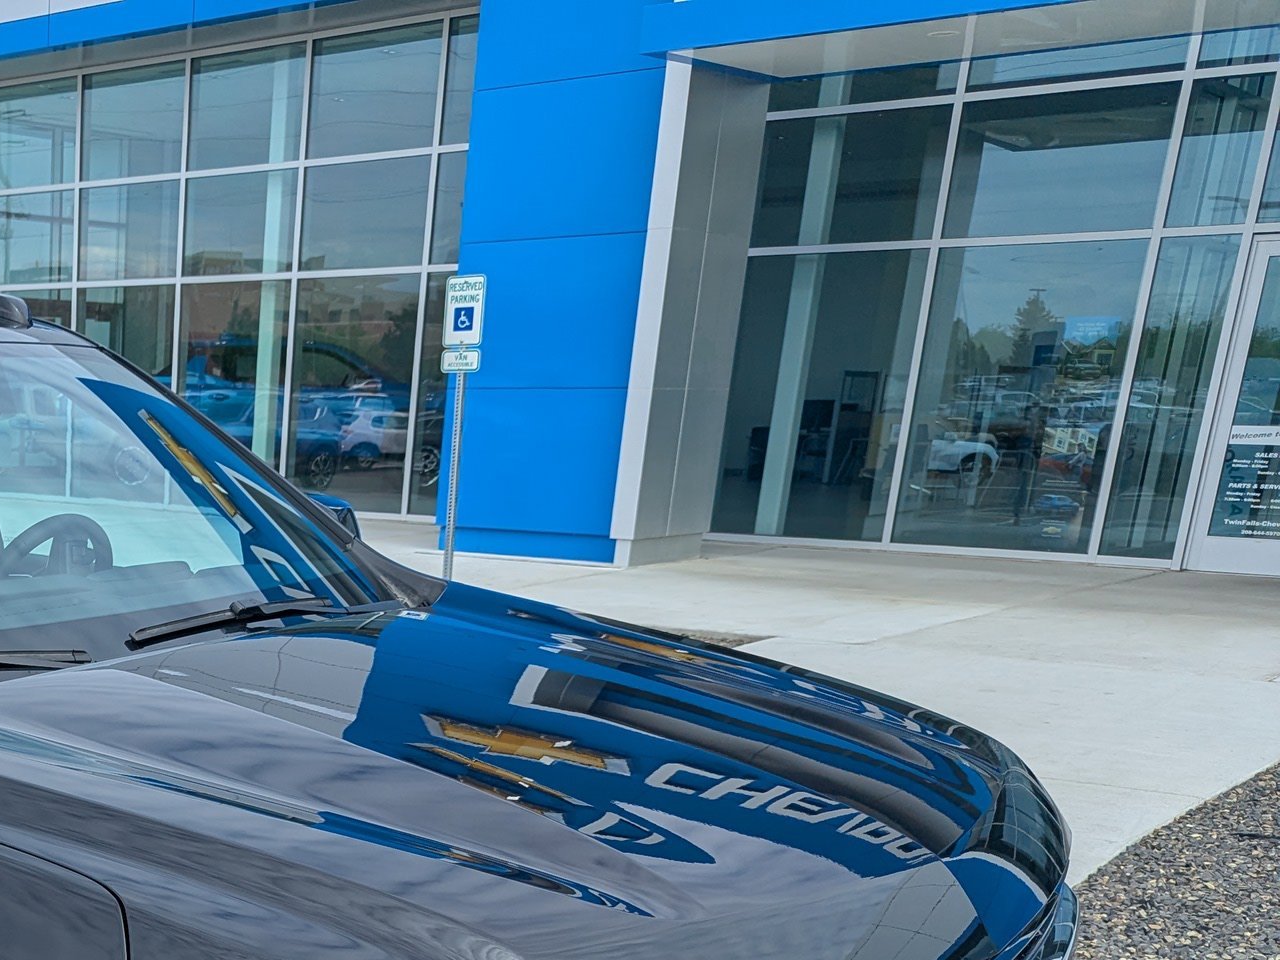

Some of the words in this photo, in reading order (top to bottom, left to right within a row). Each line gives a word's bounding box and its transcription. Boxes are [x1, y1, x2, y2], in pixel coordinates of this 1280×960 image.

[449, 281, 482, 292] RESERVED
[450, 294, 480, 304] PARKING
[1231, 432, 1272, 440] Welcome
